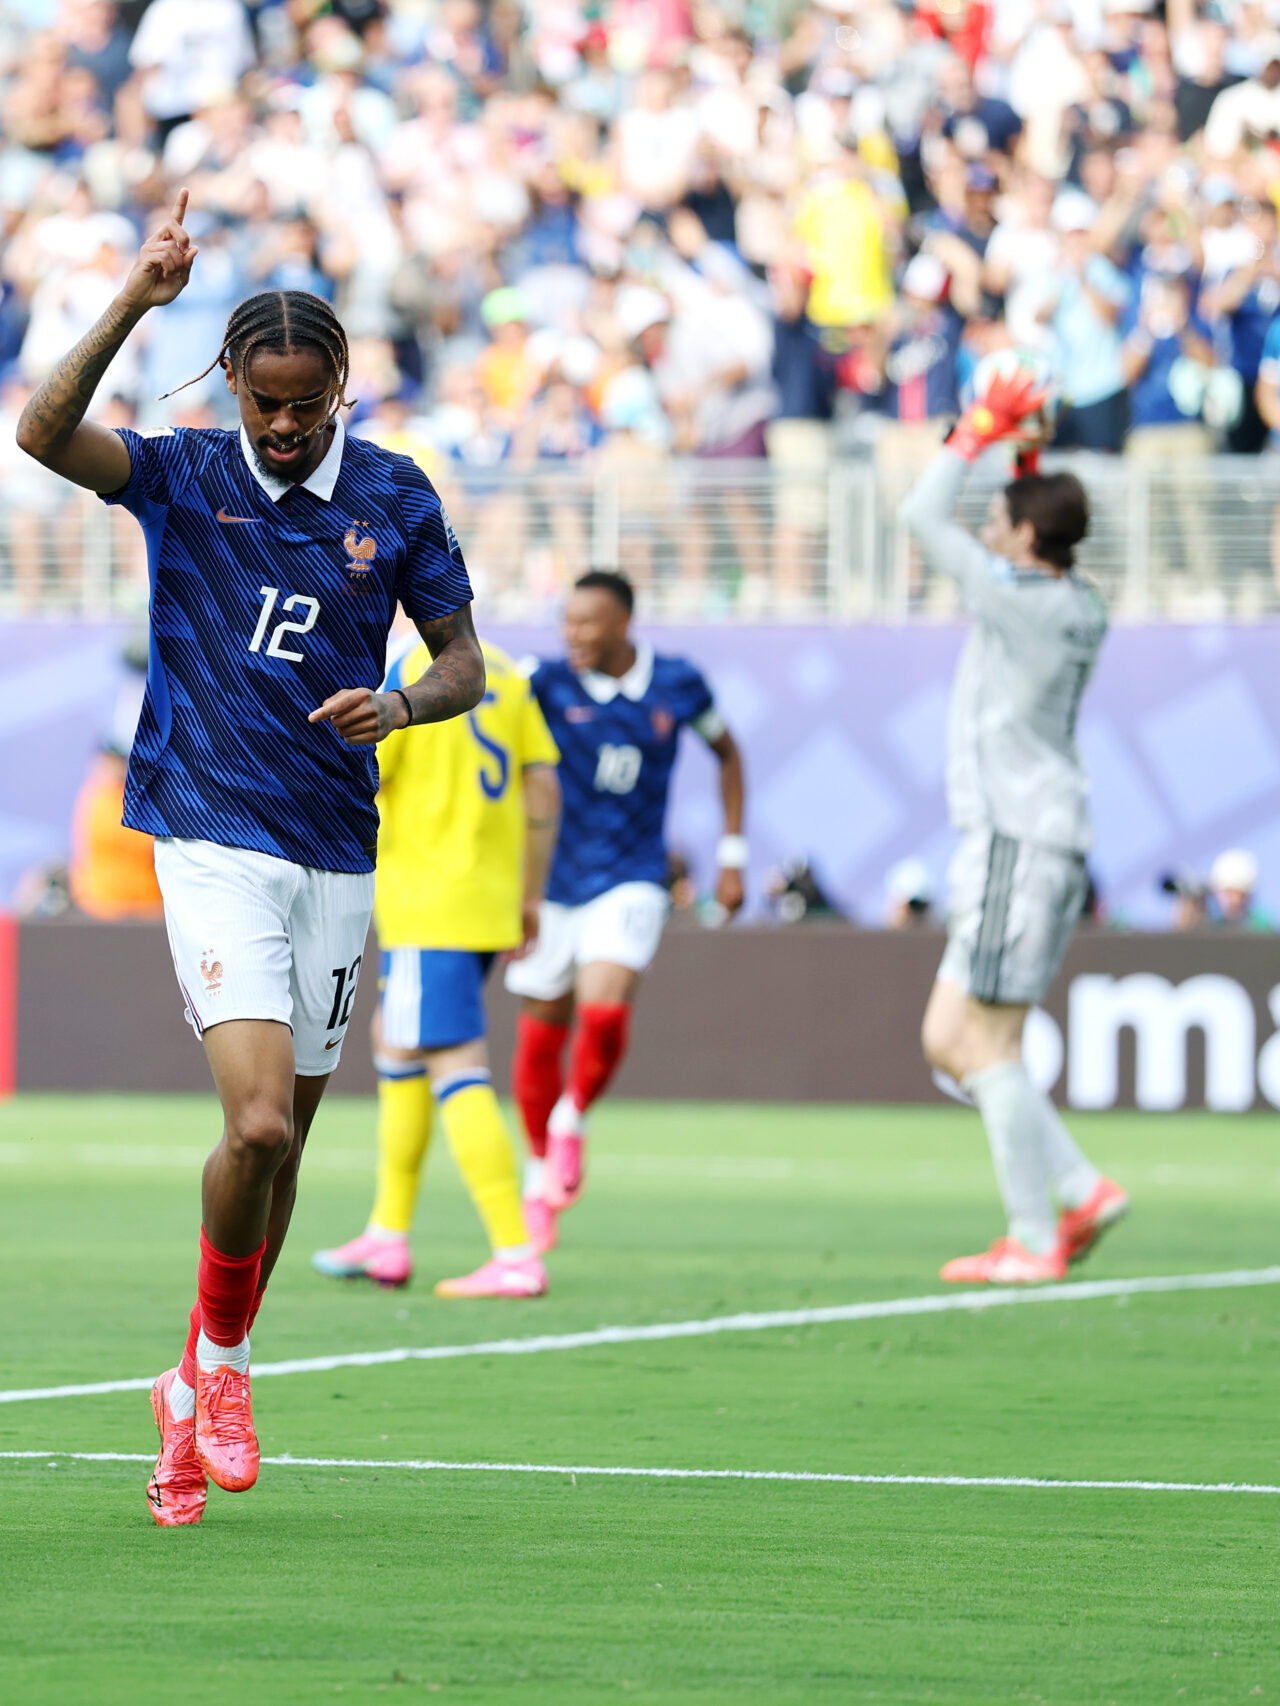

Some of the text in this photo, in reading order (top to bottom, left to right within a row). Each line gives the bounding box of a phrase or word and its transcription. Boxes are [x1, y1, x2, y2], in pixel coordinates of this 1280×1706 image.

[350, 572, 367, 580] FFF
[248, 585, 320, 663] 12
[468, 691, 509, 798] 5
[593, 742, 643, 796] 10
[326, 954, 362, 1031] 12
